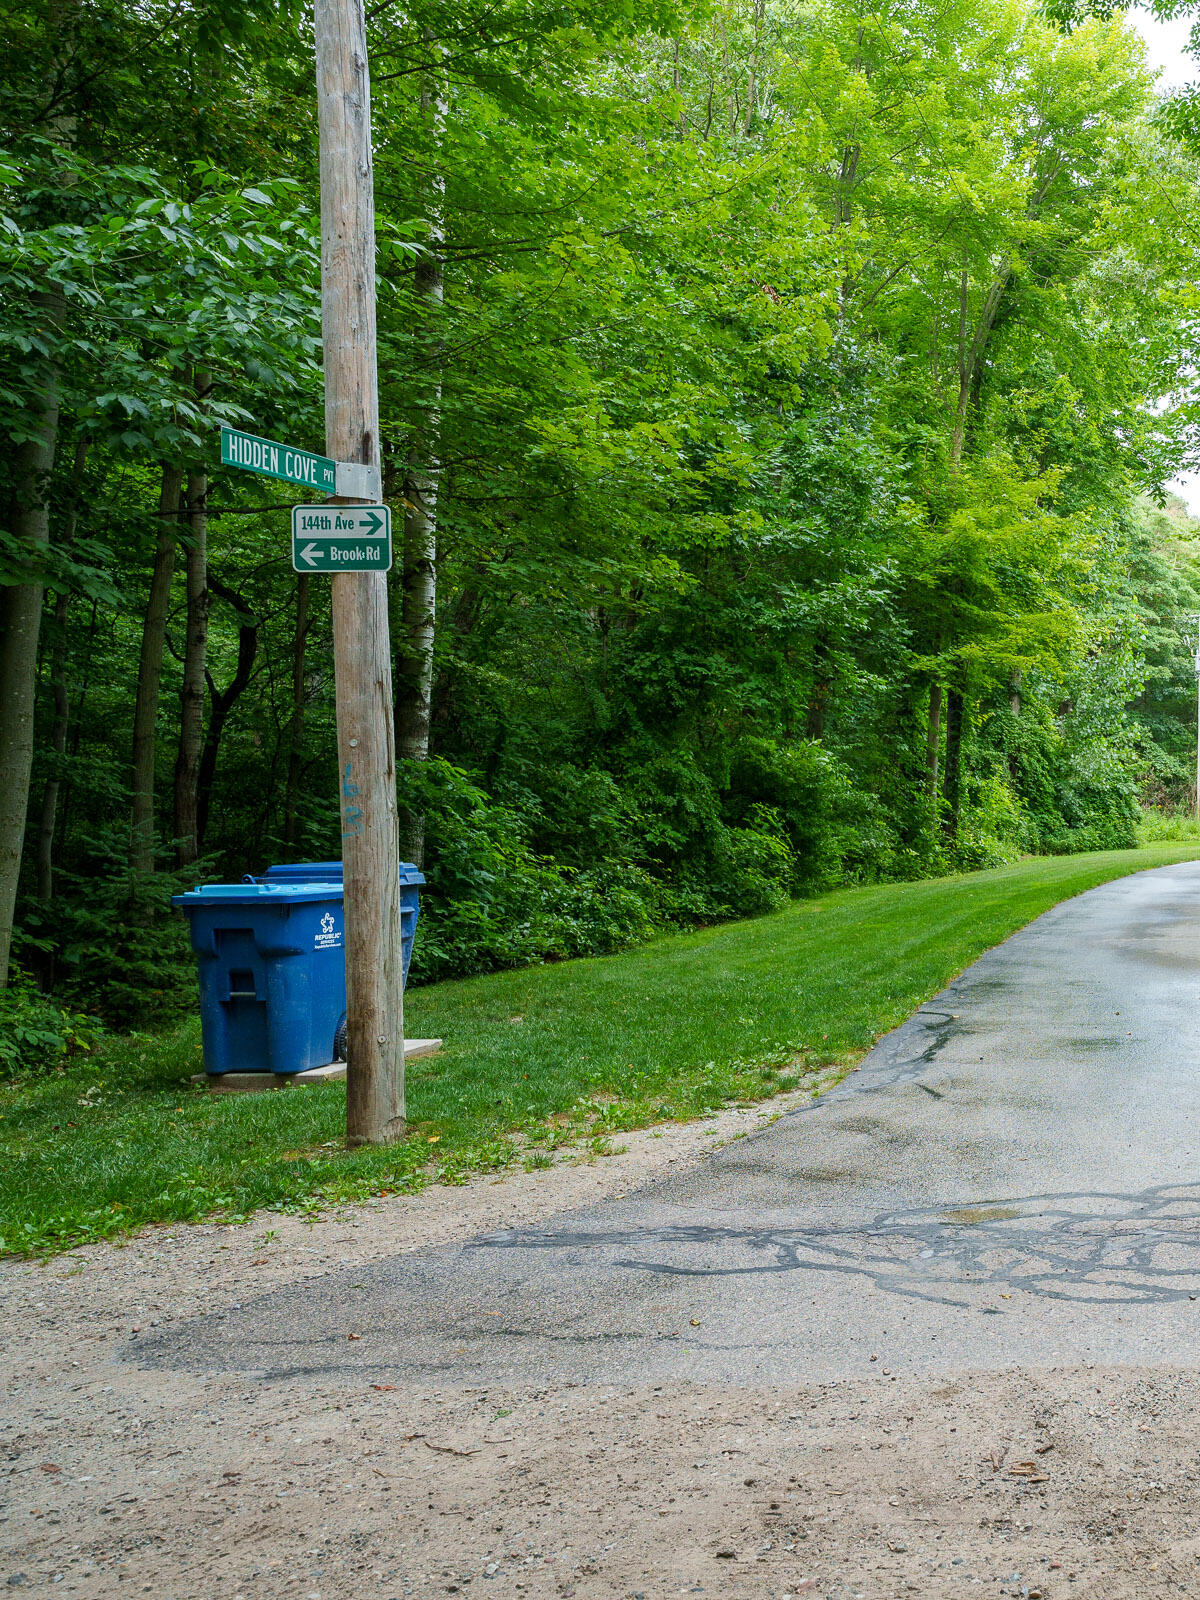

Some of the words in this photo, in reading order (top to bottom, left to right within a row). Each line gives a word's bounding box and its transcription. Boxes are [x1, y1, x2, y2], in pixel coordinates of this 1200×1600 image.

[229, 434, 278, 473] HIDDEN
[285, 451, 318, 484] COVE
[323, 468, 334, 483] PVT
[301, 515, 331, 530] 144th
[334, 515, 355, 530] Ave
[366, 546, 380, 561] Rd
